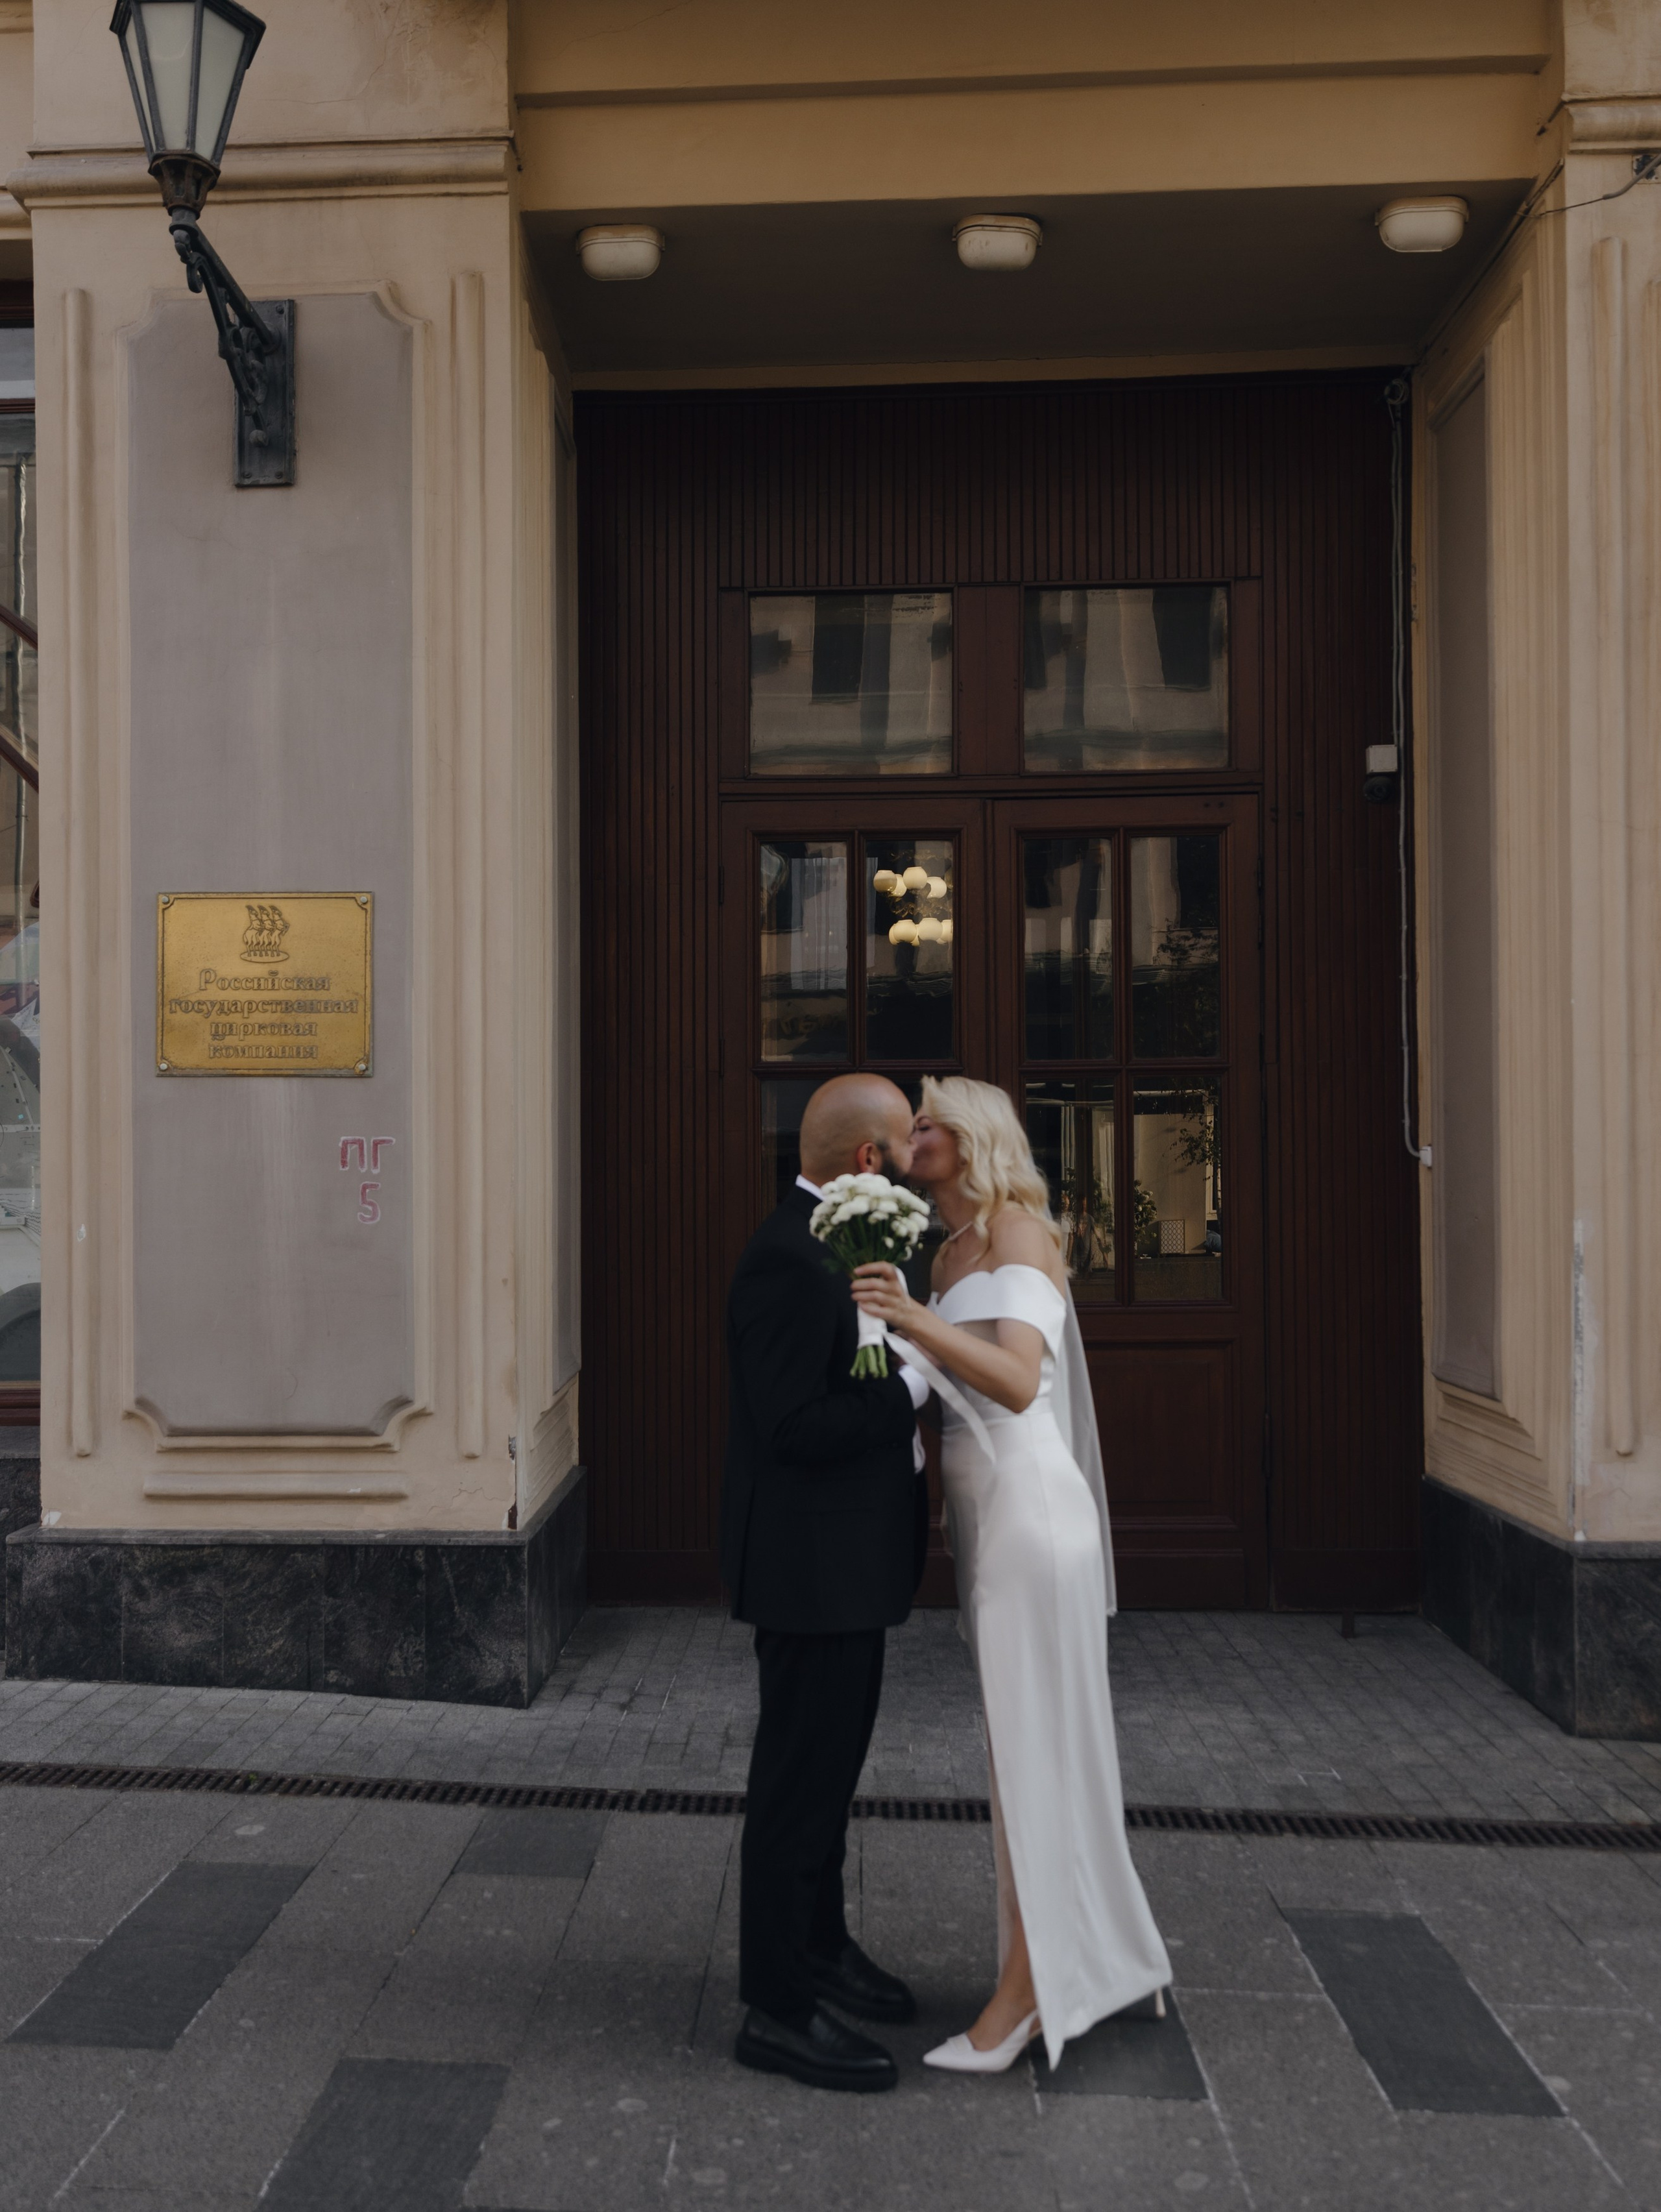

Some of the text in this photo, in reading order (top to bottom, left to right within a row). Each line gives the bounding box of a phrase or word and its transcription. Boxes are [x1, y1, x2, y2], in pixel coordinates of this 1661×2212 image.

[199, 968, 331, 991] Российская
[169, 999, 358, 1019] государственная
[210, 1022, 318, 1041] цирковая
[209, 1045, 318, 1059] компания
[358, 1181, 381, 1224] 5
